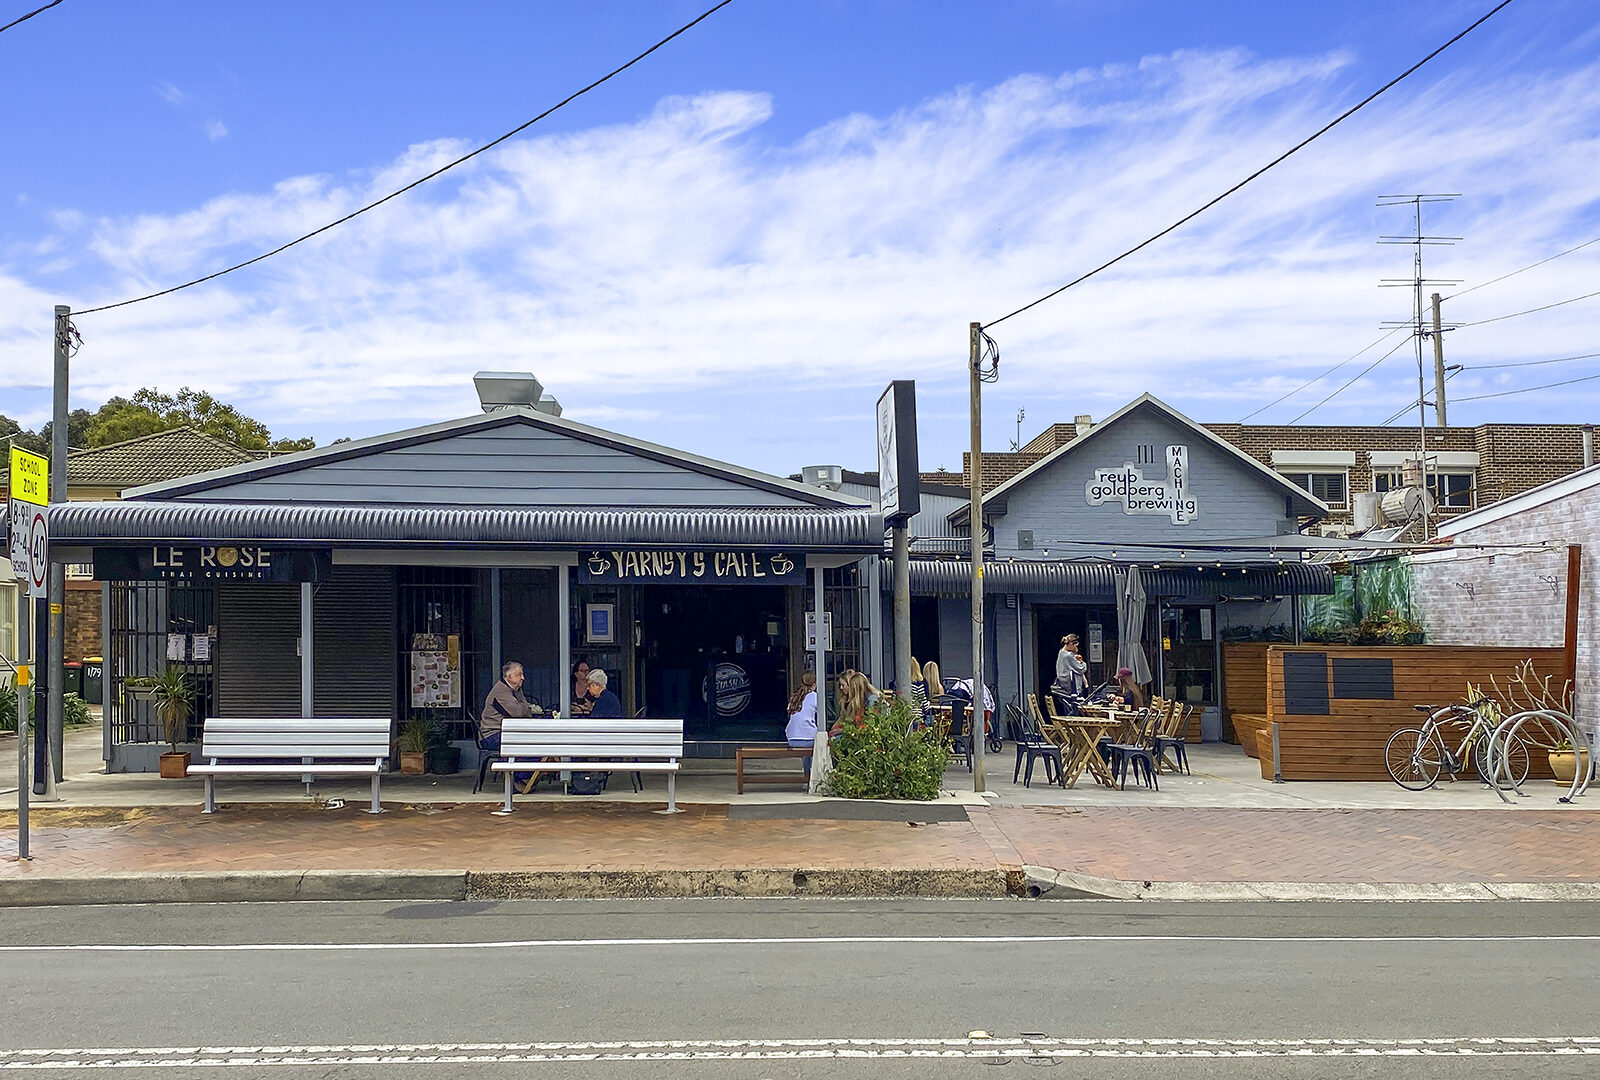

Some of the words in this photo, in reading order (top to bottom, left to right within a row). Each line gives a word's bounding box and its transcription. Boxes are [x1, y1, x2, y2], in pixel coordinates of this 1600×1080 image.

[19, 456, 41, 477] SCHOOL
[1099, 468, 1137, 483] reub
[23, 478, 38, 496] ZONE
[1091, 480, 1164, 500] goldberg
[1172, 446, 1185, 522] MACHINE
[33, 534, 45, 567] 40
[153, 546, 184, 567] LE
[200, 546, 271, 567] ROSE
[12, 560, 29, 574] SCHOOL
[611, 551, 706, 578] YARNSYS
[714, 552, 766, 577] CAFE
[87, 666, 102, 678] 1/79
